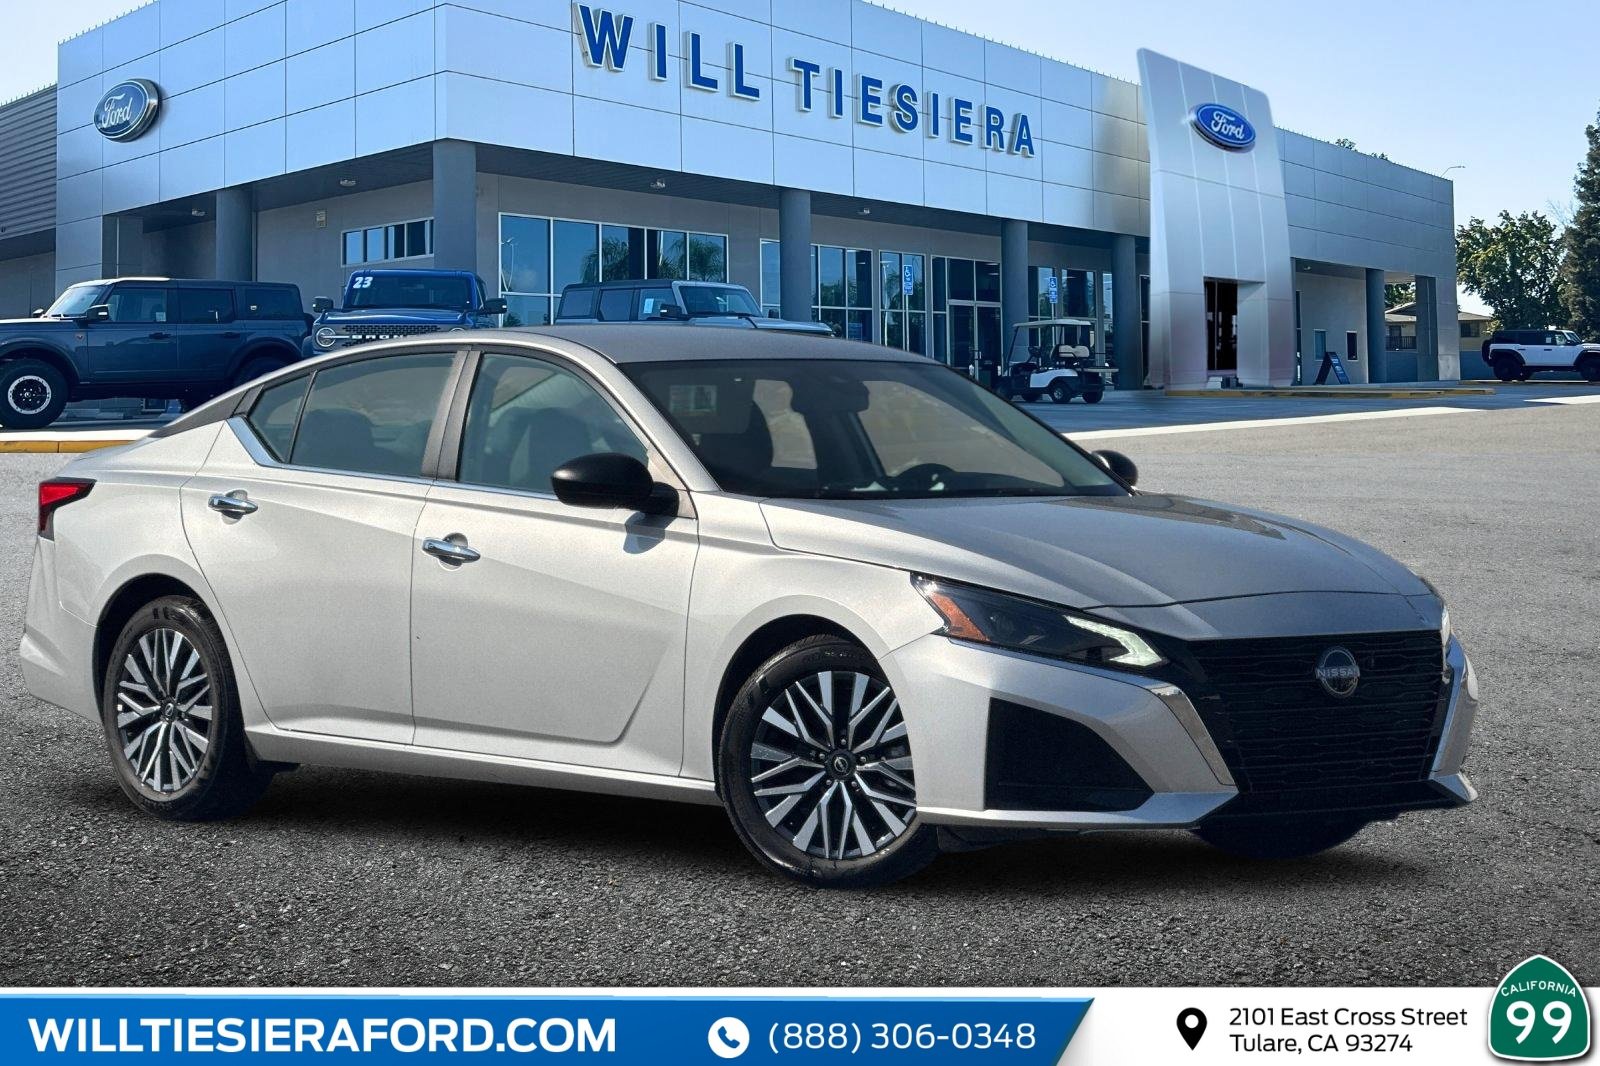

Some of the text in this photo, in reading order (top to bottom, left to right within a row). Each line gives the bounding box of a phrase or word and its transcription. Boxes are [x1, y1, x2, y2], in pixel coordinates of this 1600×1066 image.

[575, 3, 1035, 157] WILL TIESIERA
[101, 93, 133, 129] Ford
[1211, 110, 1245, 140] Ford
[353, 276, 373, 289] 23
